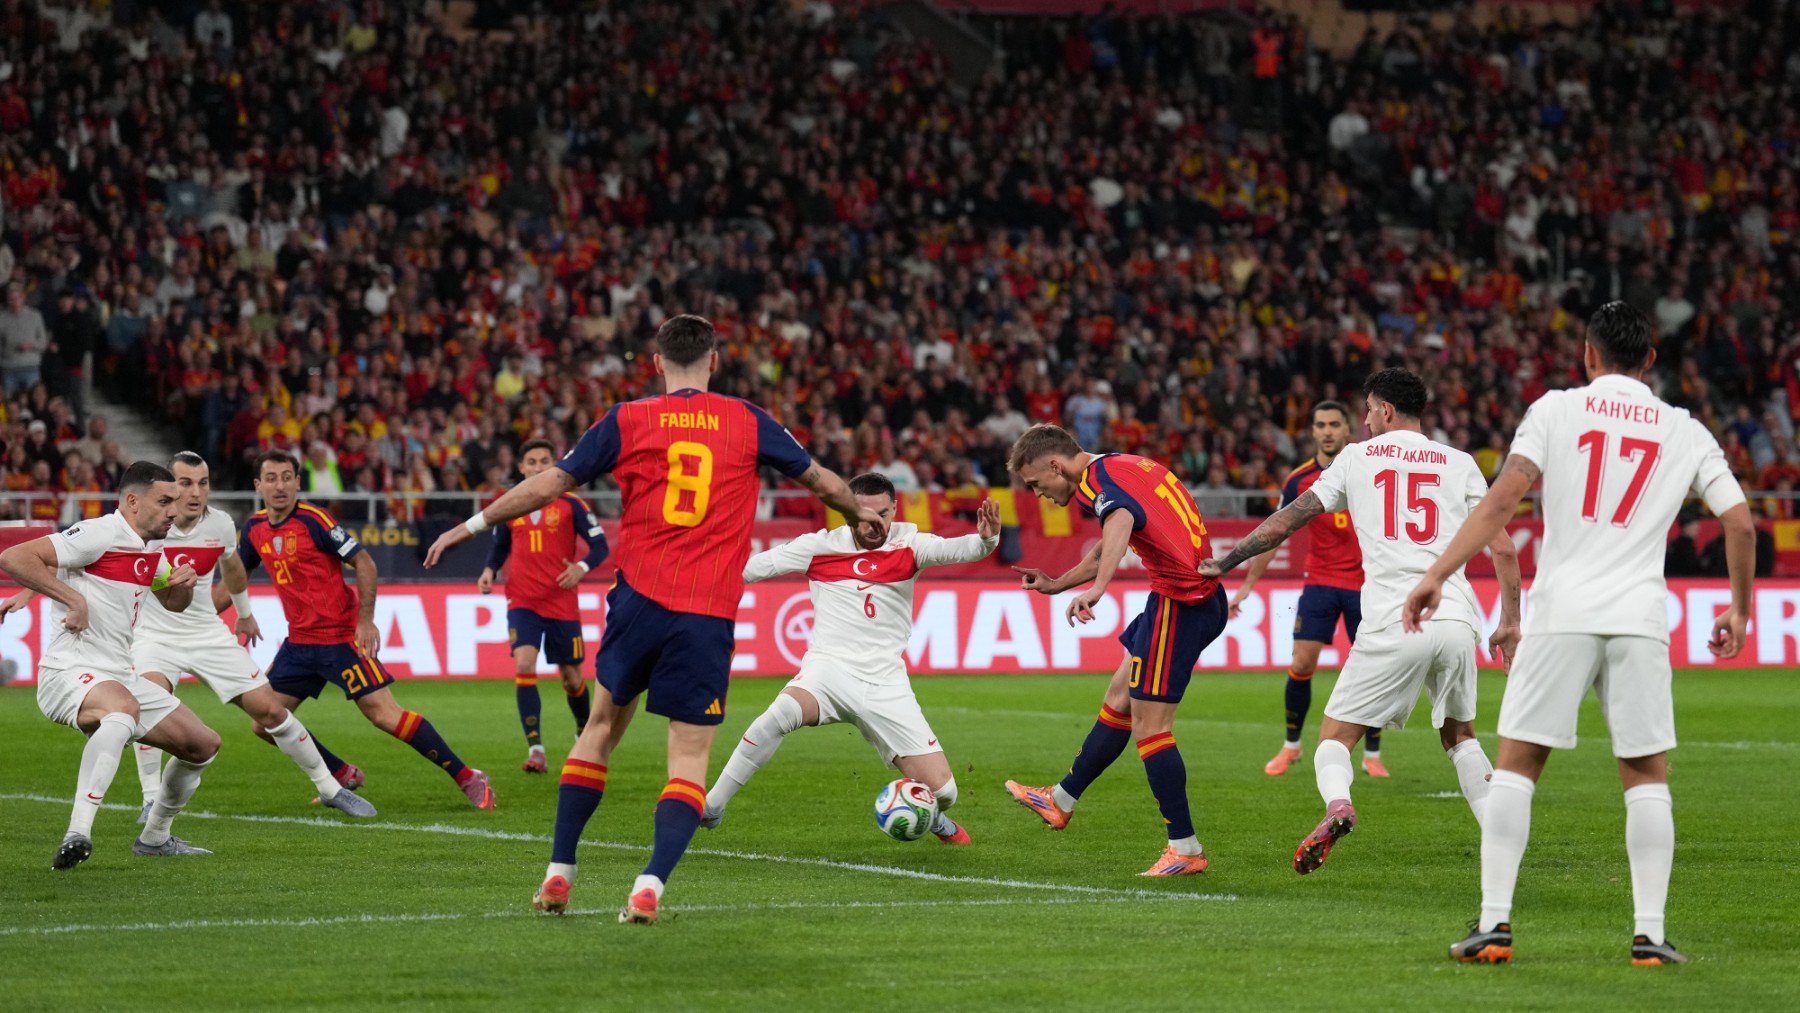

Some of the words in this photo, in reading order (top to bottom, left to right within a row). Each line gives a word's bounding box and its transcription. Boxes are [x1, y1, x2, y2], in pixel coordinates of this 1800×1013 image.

[659, 409, 719, 431] FABIÁN
[1365, 444, 1402, 459] SAMET
[1402, 449, 1447, 465] AKAYDIN
[662, 440, 713, 528] 8
[1577, 429, 1662, 529] 17
[1374, 468, 1441, 546] 15
[529, 529, 543, 553] 11
[273, 560, 294, 585] 21
[863, 593, 878, 620] 6
[79, 672, 94, 685] 3
[341, 663, 369, 694] 21
